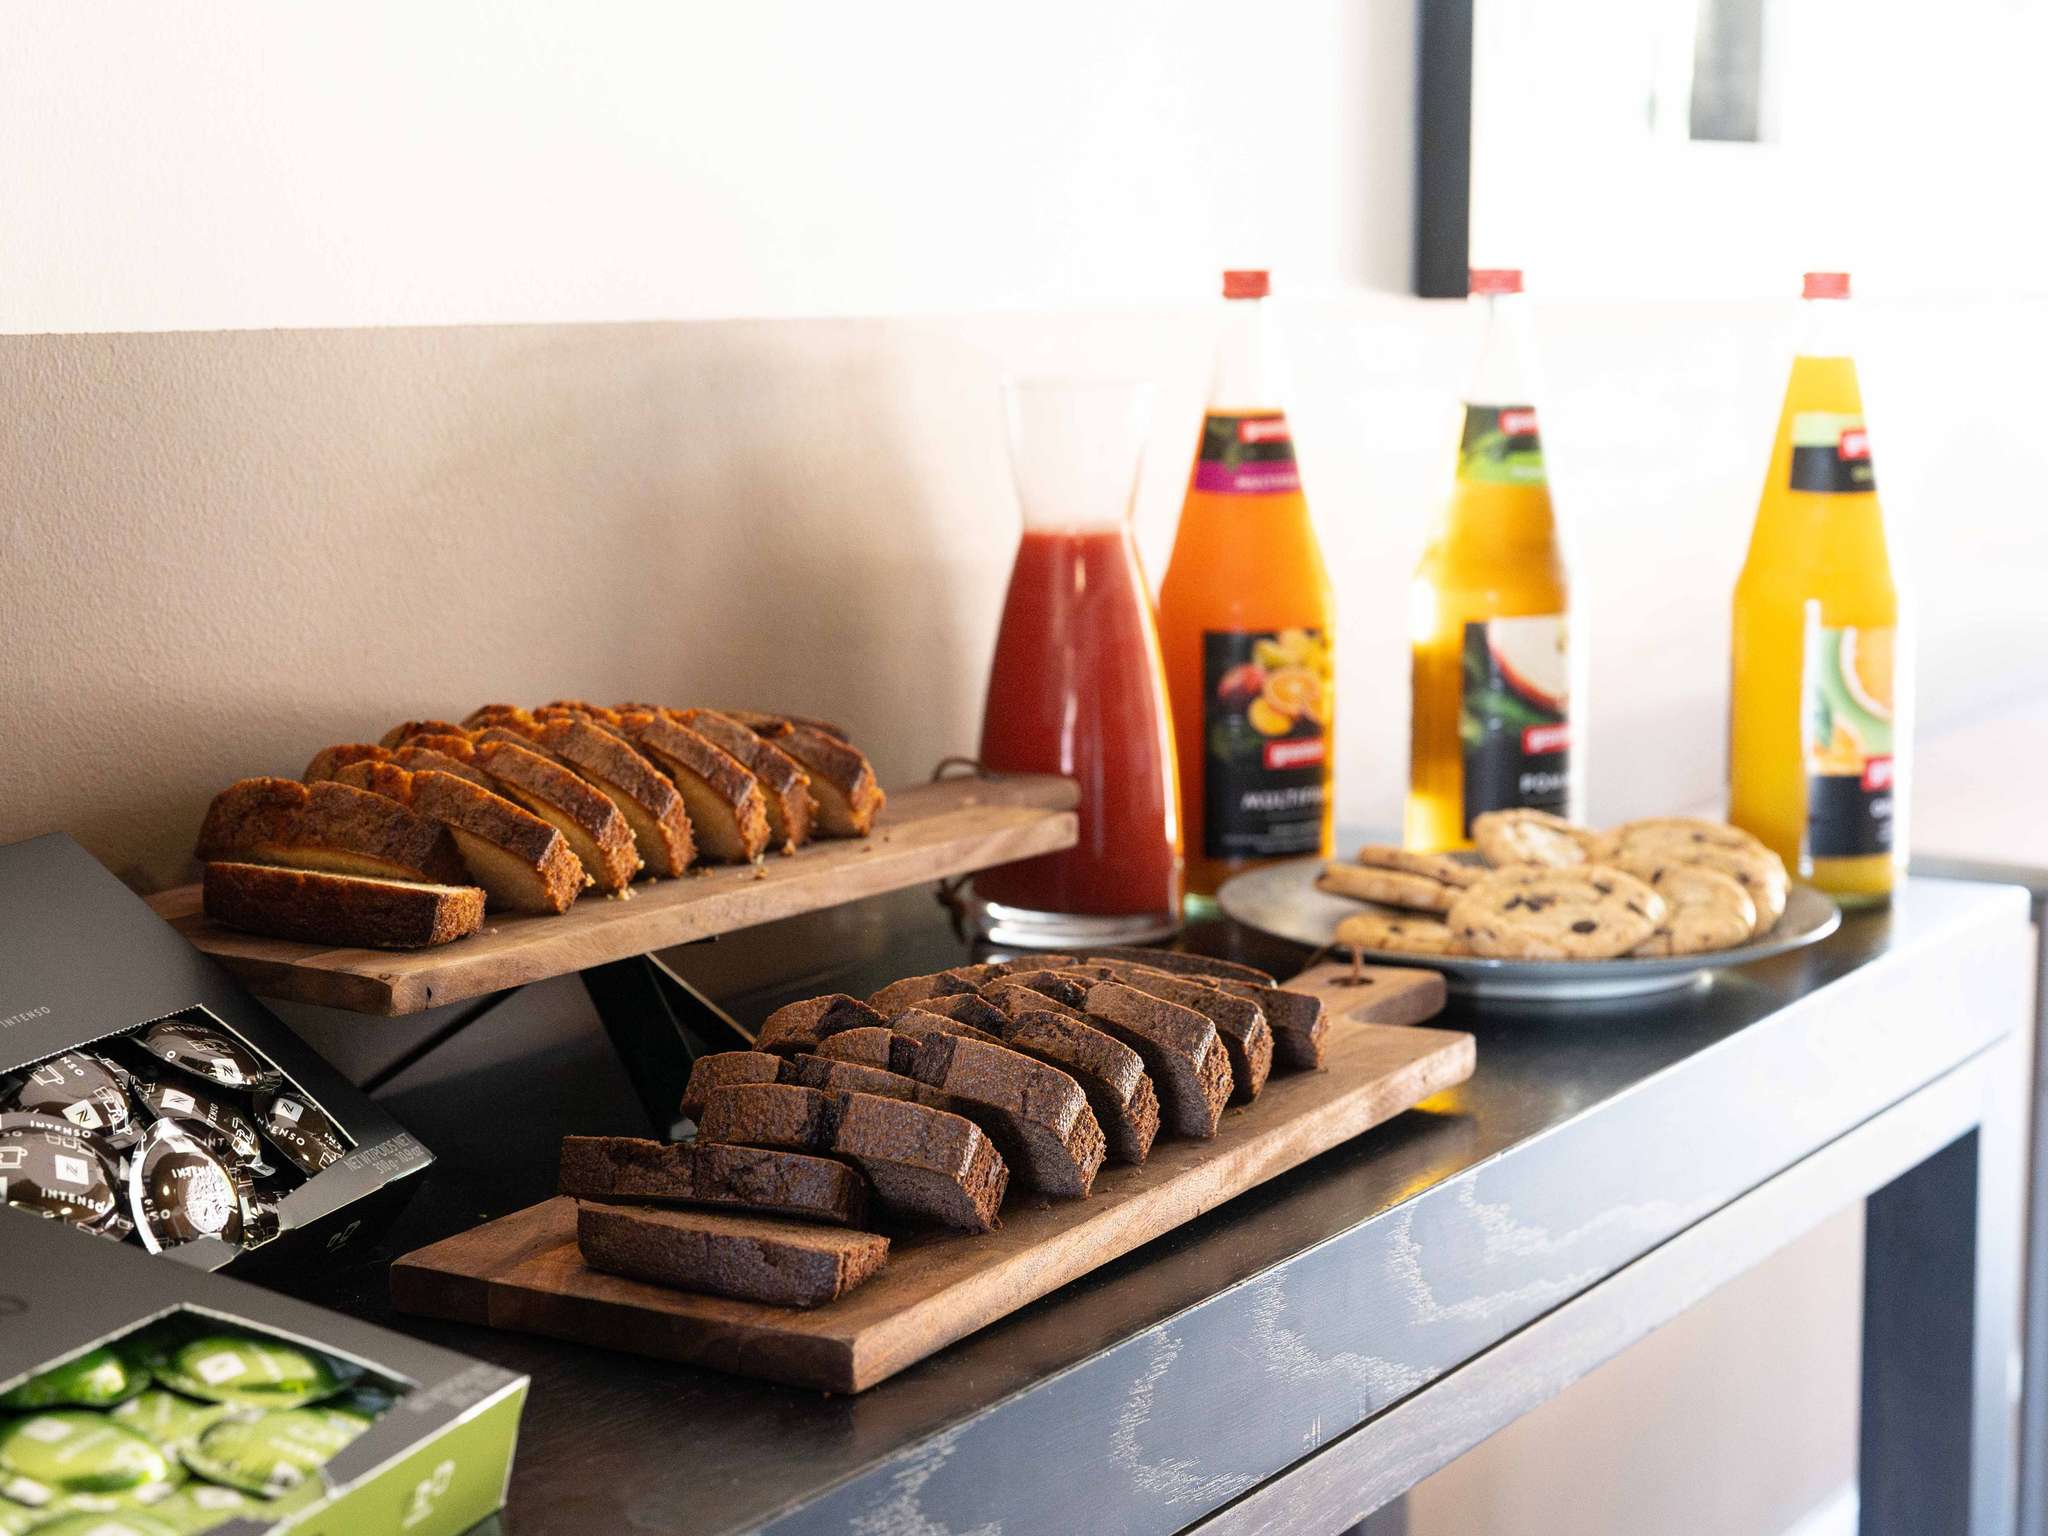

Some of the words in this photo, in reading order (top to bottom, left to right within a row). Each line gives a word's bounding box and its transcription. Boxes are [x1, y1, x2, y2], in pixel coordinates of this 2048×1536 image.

[0, 1006, 51, 1029] INTENSO
[30, 1120, 92, 1138] INTENSO
[41, 1187, 105, 1214] INTENSO
